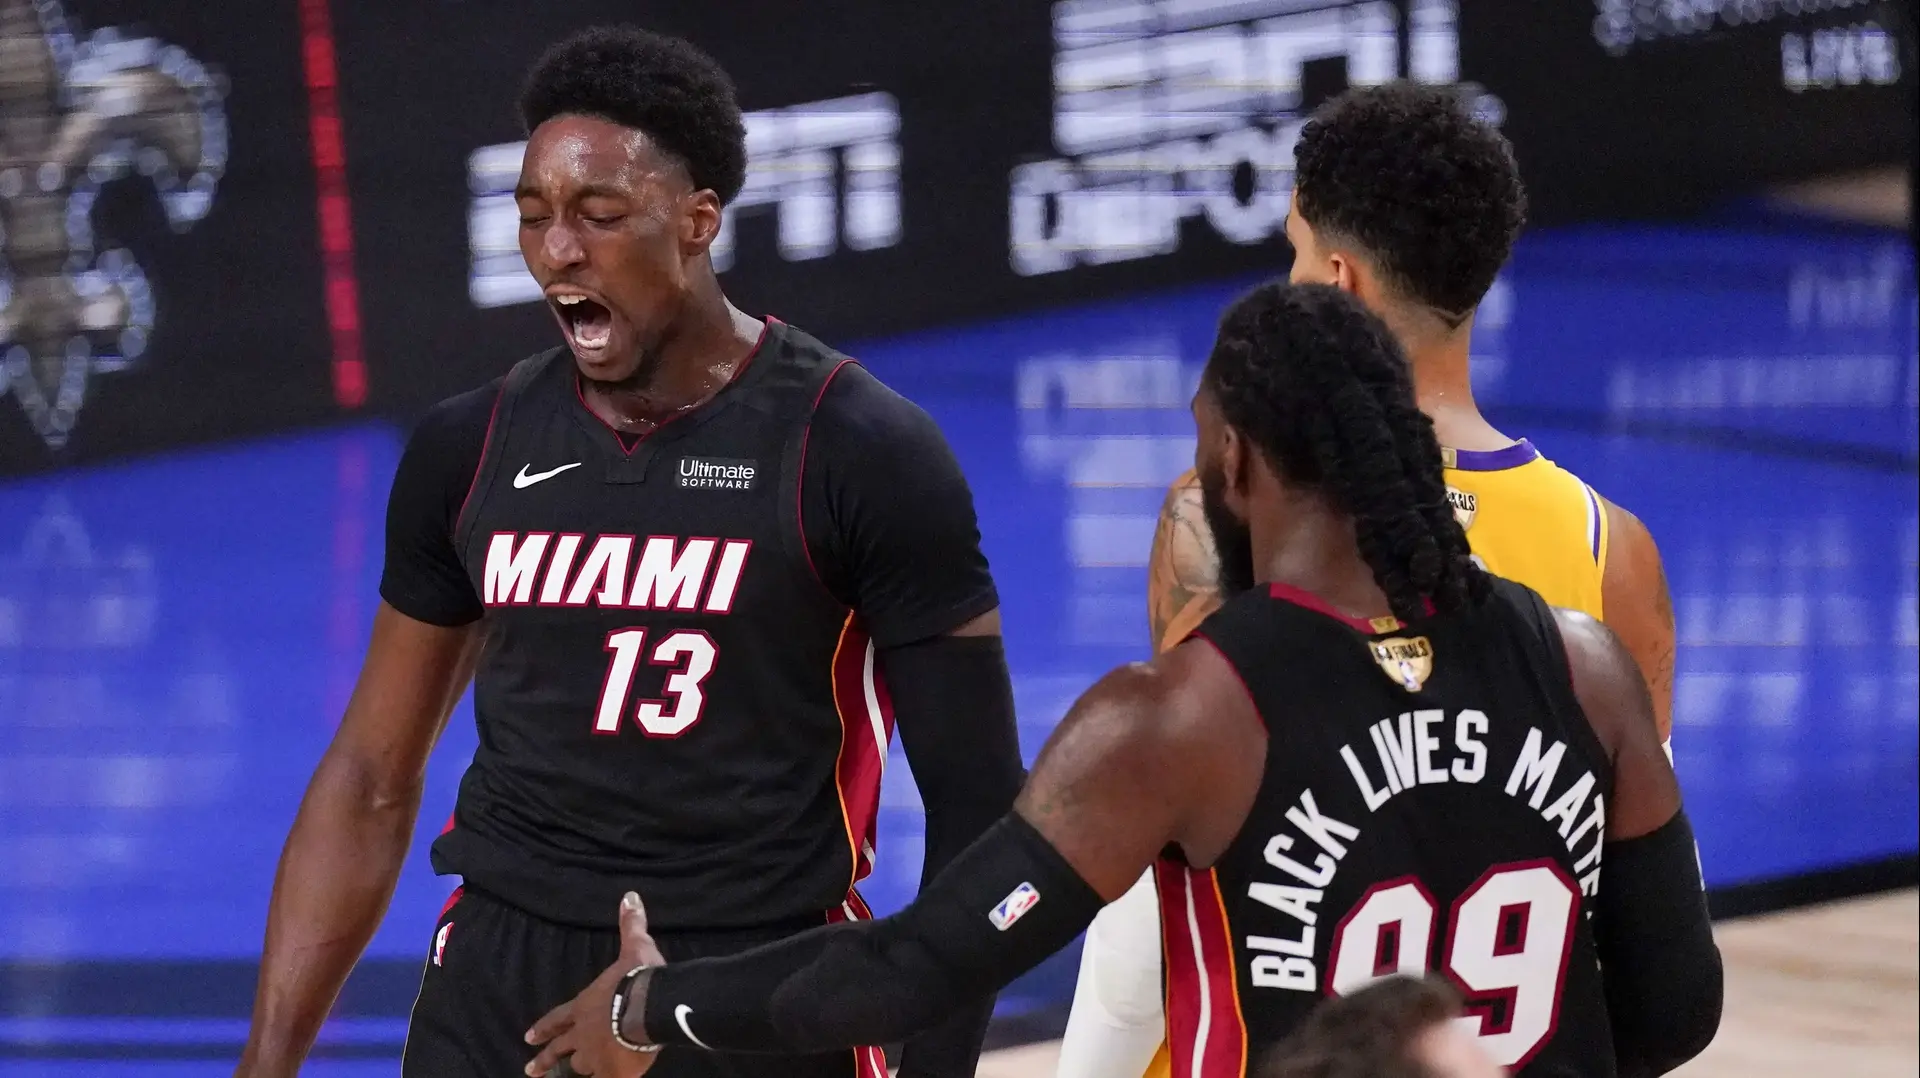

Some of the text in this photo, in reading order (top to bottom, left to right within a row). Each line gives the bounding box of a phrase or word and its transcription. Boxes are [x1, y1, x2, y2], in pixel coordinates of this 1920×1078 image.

[680, 459, 755, 480] Ultimate
[681, 478, 750, 489] SOFTWARE
[481, 531, 753, 615] MIAMI
[591, 626, 720, 740] 13
[1246, 708, 1606, 993] BLACK LIVES MATTE
[1322, 857, 1584, 1077] 99
